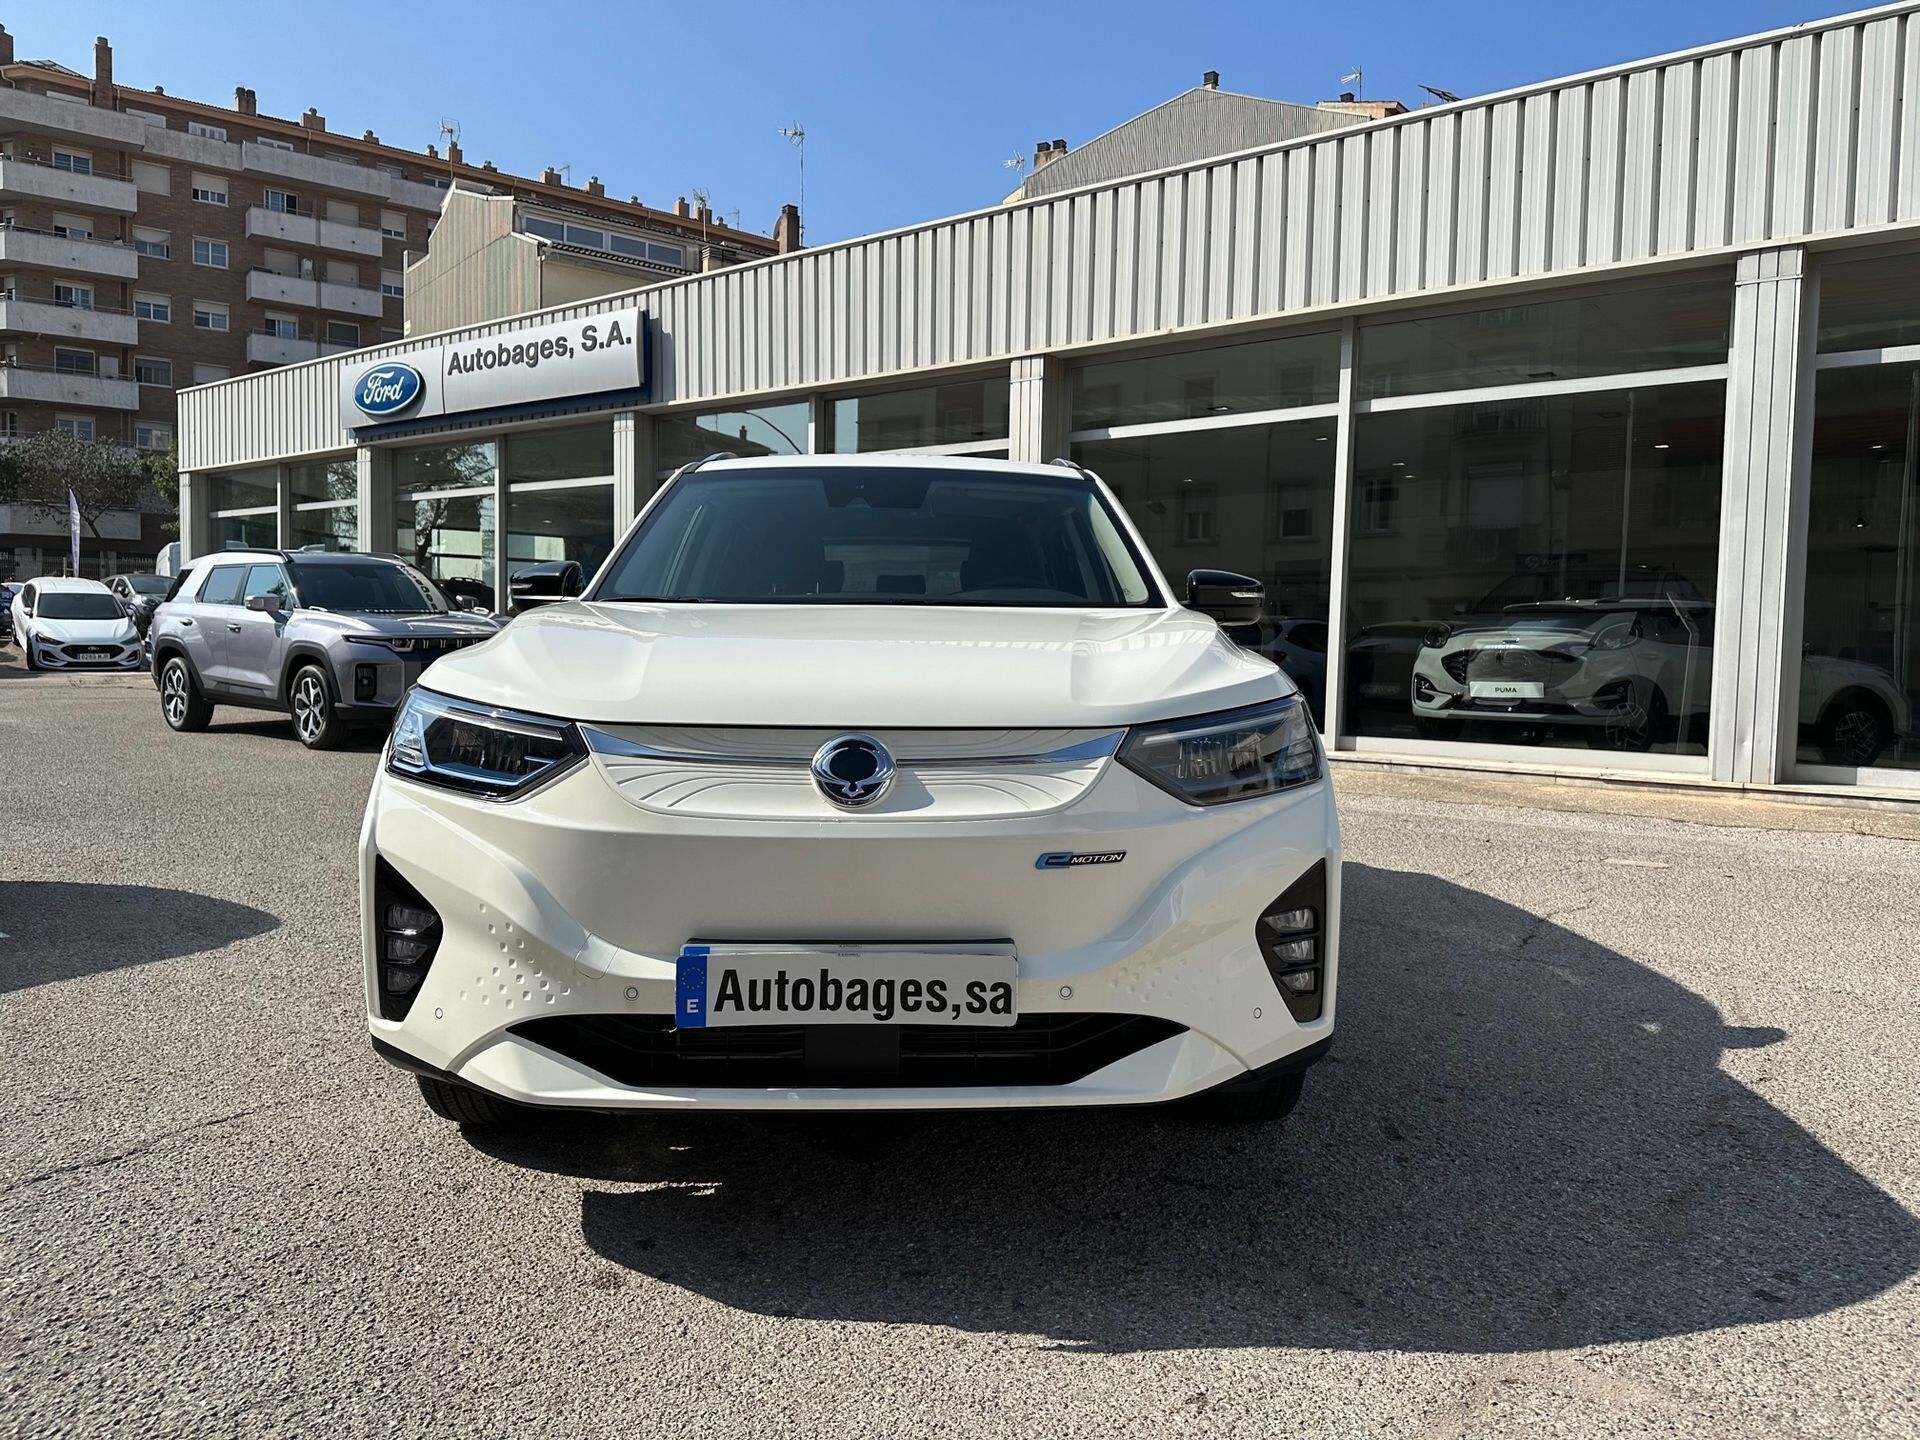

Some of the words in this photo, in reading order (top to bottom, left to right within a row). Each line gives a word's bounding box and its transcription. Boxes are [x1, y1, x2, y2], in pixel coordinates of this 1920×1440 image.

[447, 335, 574, 376] Autobages,
[581, 320, 632, 351] S.A.
[363, 370, 406, 405] Ford
[686, 998, 699, 1014] E
